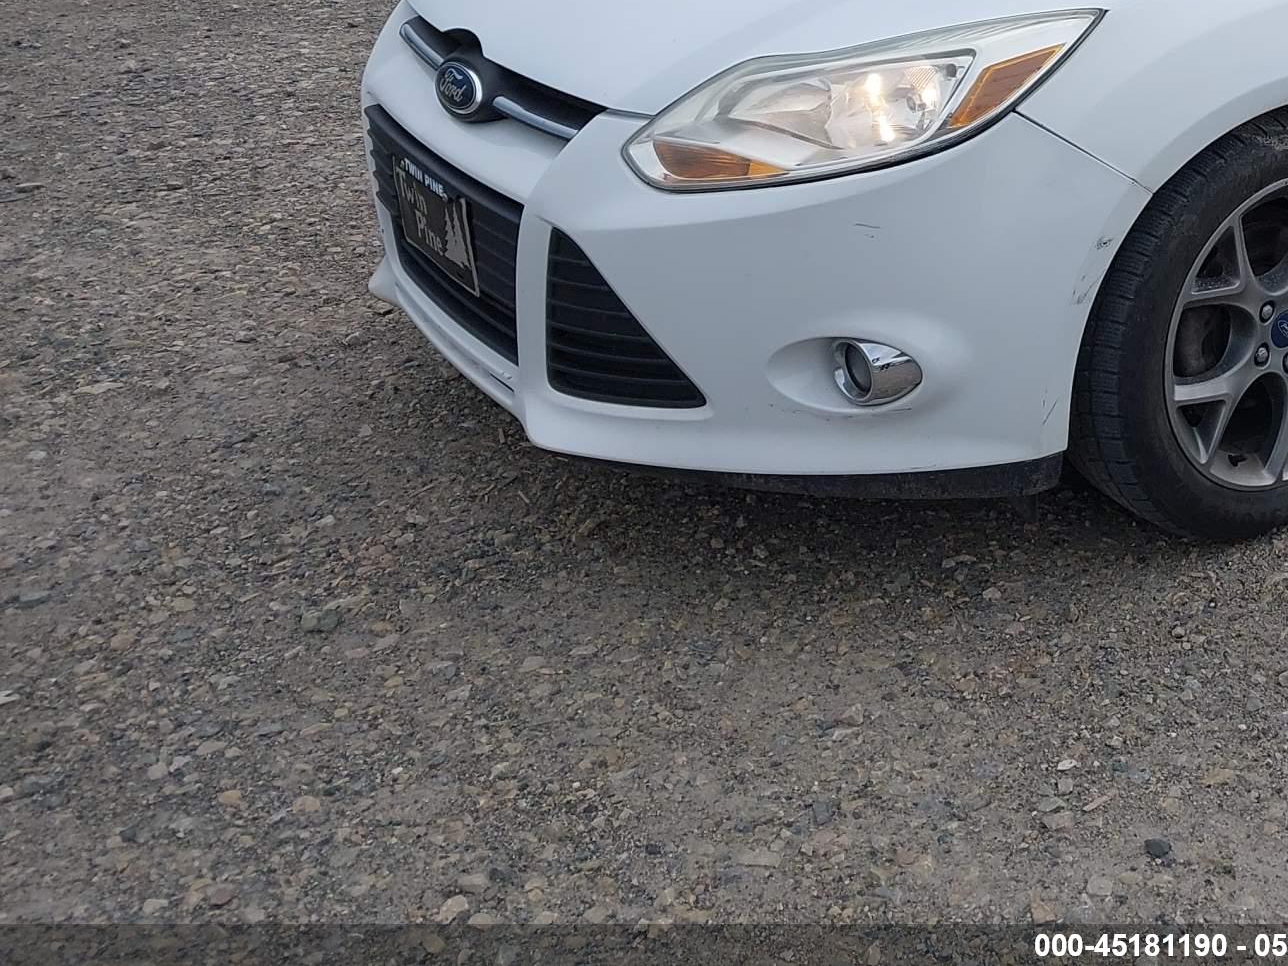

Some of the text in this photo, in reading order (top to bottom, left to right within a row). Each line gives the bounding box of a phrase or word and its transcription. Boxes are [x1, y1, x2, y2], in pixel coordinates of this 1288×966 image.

[440, 68, 466, 102] Ford
[396, 166, 428, 215] Twin
[404, 158, 445, 197] TWIN PINE
[415, 209, 444, 256] Pine
